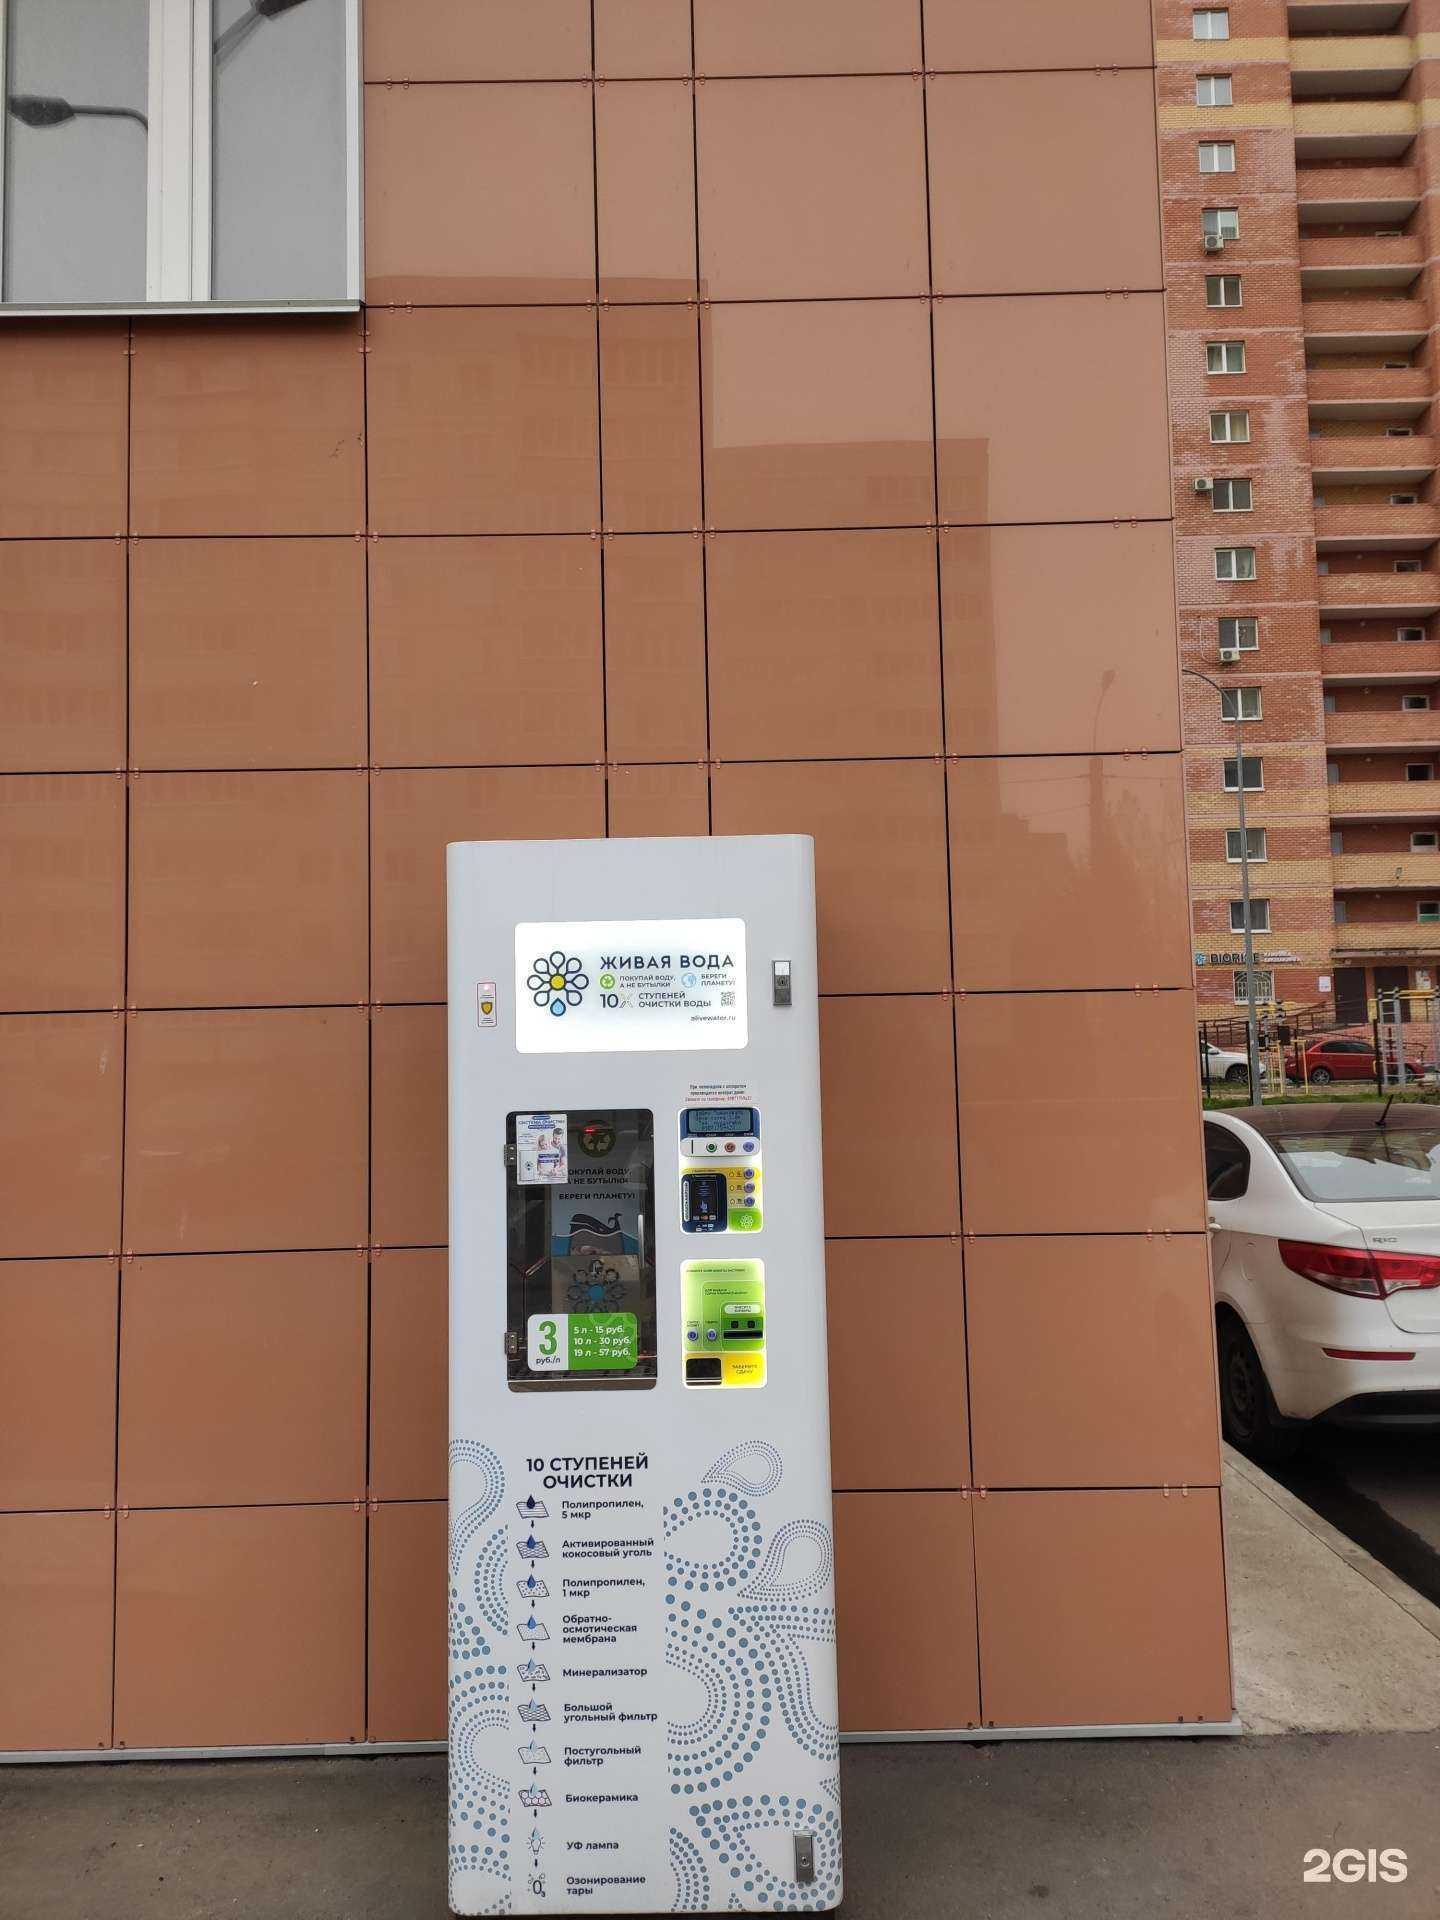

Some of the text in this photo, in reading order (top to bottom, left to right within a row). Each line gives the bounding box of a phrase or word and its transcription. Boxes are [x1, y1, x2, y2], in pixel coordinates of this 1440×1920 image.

[600, 954, 735, 970] ЖИВАЯ ВОДА
[619, 974, 676, 982] ПОКУПАЙ ВОДУ,
[638, 991, 686, 1000] СТУПЕНЕЙ
[600, 994, 619, 1008] 10
[638, 1000, 712, 1008] ОЧИСТКИ ВОДЫ
[690, 1014, 736, 1022] alivewater.ru
[568, 1167, 604, 1175] ОКУПАЙ
[574, 1177, 586, 1185] НЕ
[559, 1192, 636, 1200] БЕРЕГИ ПЛАНЕТУ!
[595, 1326, 604, 1334] 15
[606, 1325, 625, 1335] руб.
[539, 1320, 558, 1356] 3
[573, 1337, 584, 1345] 10
[599, 1337, 611, 1345] 30
[612, 1336, 632, 1347] руб.
[573, 1349, 584, 1357] 19
[599, 1348, 610, 1356] 57
[612, 1348, 631, 1358] руб.
[536, 1355, 561, 1365] руб./л
[526, 1452, 649, 1473] 10 СТУПЕНЕЙ
[543, 1473, 633, 1489] ОЧИСТКИ
[562, 1500, 644, 1510] Полипропилен,
[562, 1510, 591, 1520] 5 мкр
[562, 1538, 654, 1549] Активированный
[562, 1549, 653, 1559] кокосовый уголь
[562, 1578, 645, 1588] Полипропилен,
[562, 1589, 590, 1599] 1 мкр
[562, 1614, 612, 1625] Обратно-
[562, 1625, 637, 1634] осмотическая
[562, 1634, 617, 1644] мембрана
[562, 1667, 648, 1678] Минерализатор
[563, 1702, 613, 1713] Большой
[563, 1710, 658, 1724] угольный фильтр
[563, 1746, 642, 1757] Постугольный
[563, 1757, 604, 1768] фильтр
[565, 1793, 639, 1803] Биокерамика
[566, 1841, 619, 1851] УФ лампа
[566, 1875, 647, 1886] Озонирование
[566, 1886, 594, 1896] тары
